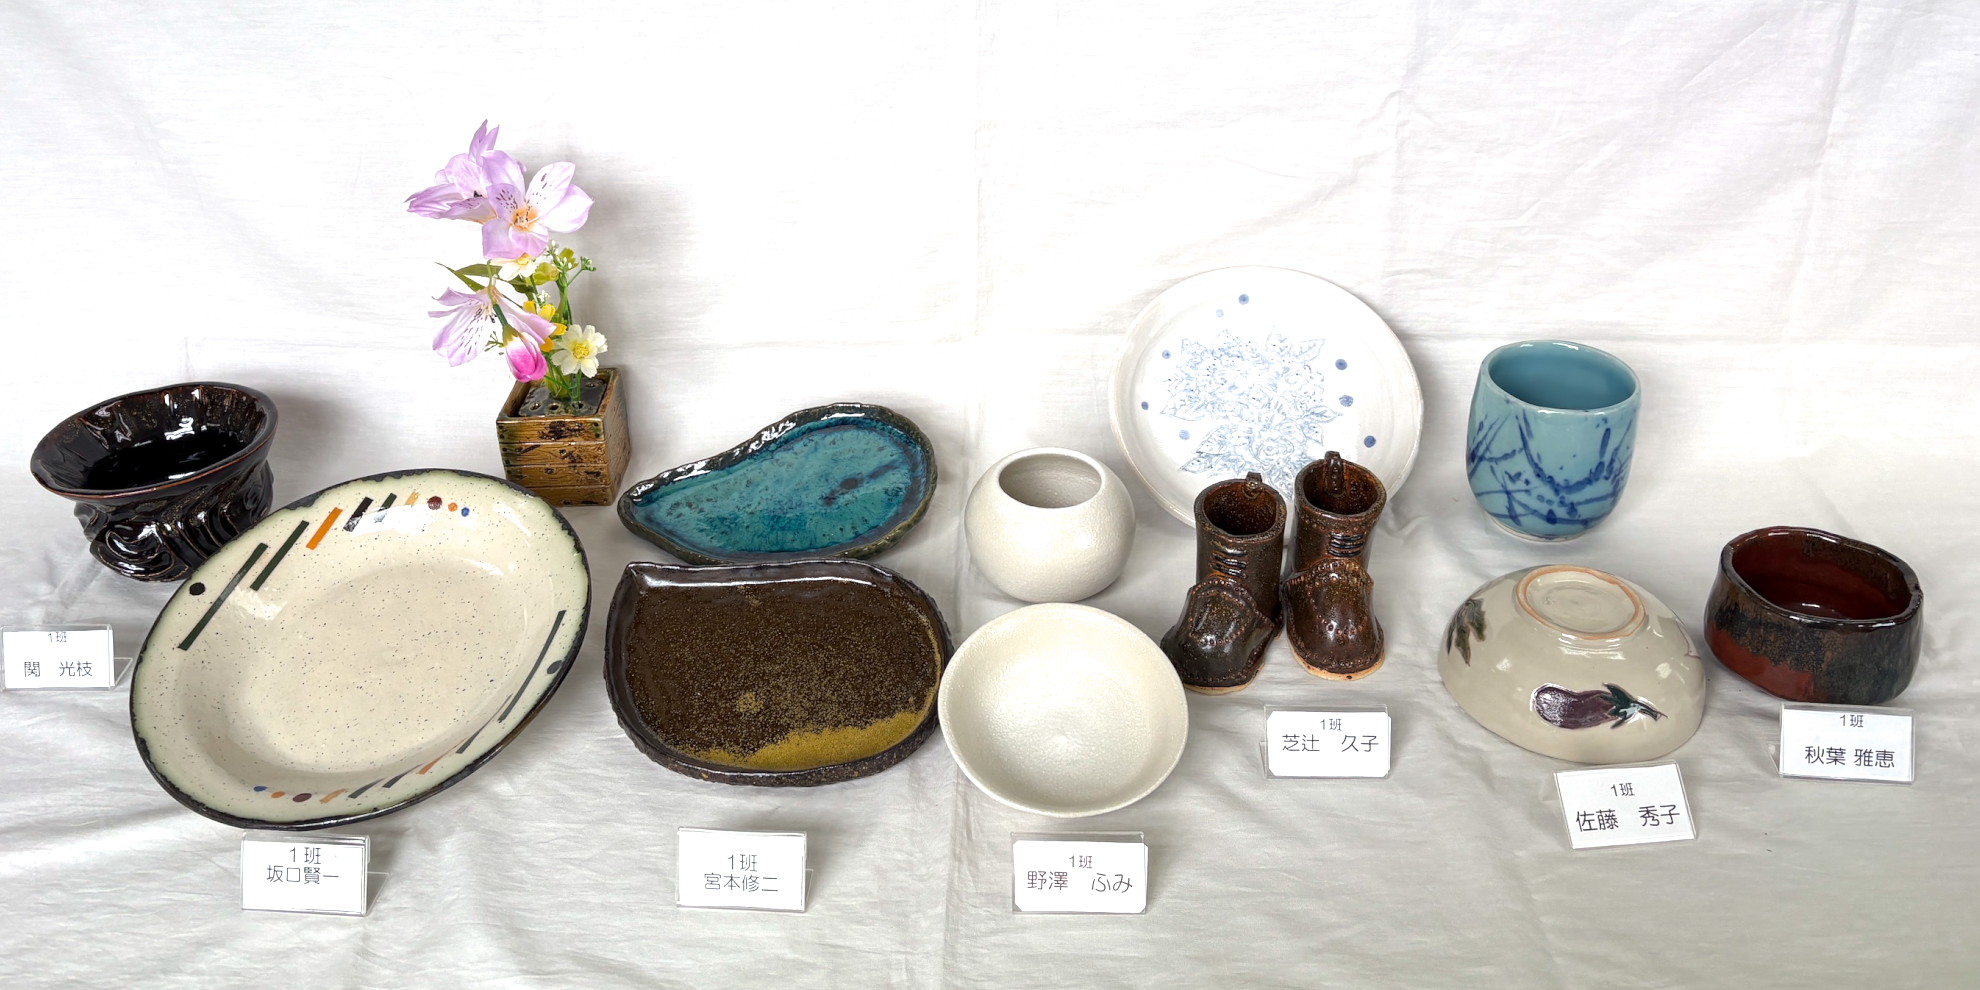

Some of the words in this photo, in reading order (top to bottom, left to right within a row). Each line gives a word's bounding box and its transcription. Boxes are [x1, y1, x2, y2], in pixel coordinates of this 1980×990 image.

[48, 631, 67, 642] 1班
[24, 661, 40, 677] 関
[59, 661, 93, 677] 光枝
[1320, 718, 1342, 731] 1班
[1840, 714, 1864, 728] 1班
[1282, 733, 1320, 752] 芝辻
[1341, 734, 1379, 752] 久子
[1804, 745, 1846, 766] 秋葉
[1854, 748, 1895, 768] 雅恵
[1610, 782, 1635, 797] 1班
[1575, 808, 1619, 832] 佐藤
[1638, 804, 1680, 827] 秀子
[289, 847, 321, 865] 1班
[727, 854, 758, 872] 1班
[1069, 854, 1093, 869] 1班
[266, 865, 339, 884] 坂口賢一
[704, 872, 779, 892] 宮本修二
[1027, 870, 1068, 890] 野澤
[1091, 872, 1133, 893] ふみ
